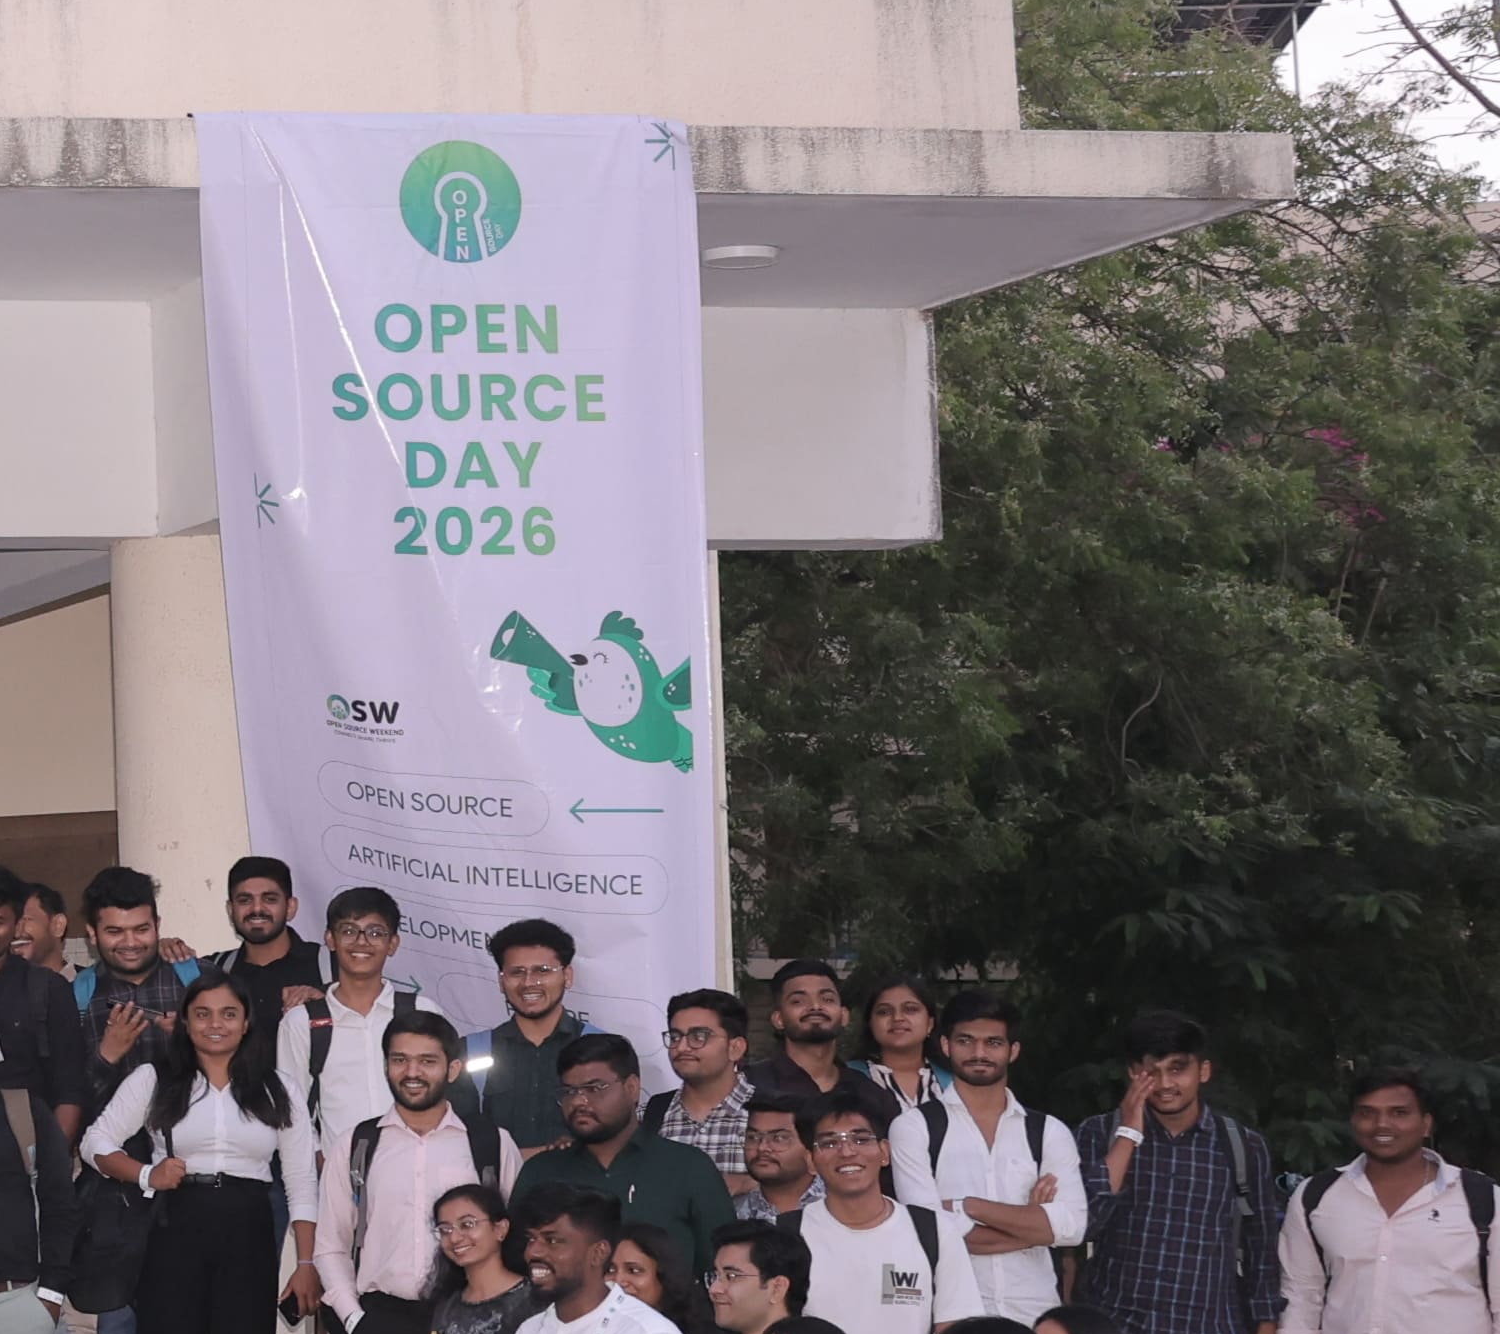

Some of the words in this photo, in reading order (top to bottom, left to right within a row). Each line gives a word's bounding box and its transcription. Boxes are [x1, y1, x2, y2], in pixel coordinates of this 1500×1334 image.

[451, 190, 469, 261] OPEN
[482, 219, 498, 253] SOURCE
[374, 303, 560, 355] OPEN
[331, 371, 606, 424] SOURCE
[406, 440, 543, 491] DAY
[393, 505, 557, 558] 2026
[346, 781, 405, 812] OPEN
[409, 791, 514, 820] SOURCE
[346, 843, 458, 884] ARTIFICIAL
[465, 861, 644, 898] INTELLIGENCE
